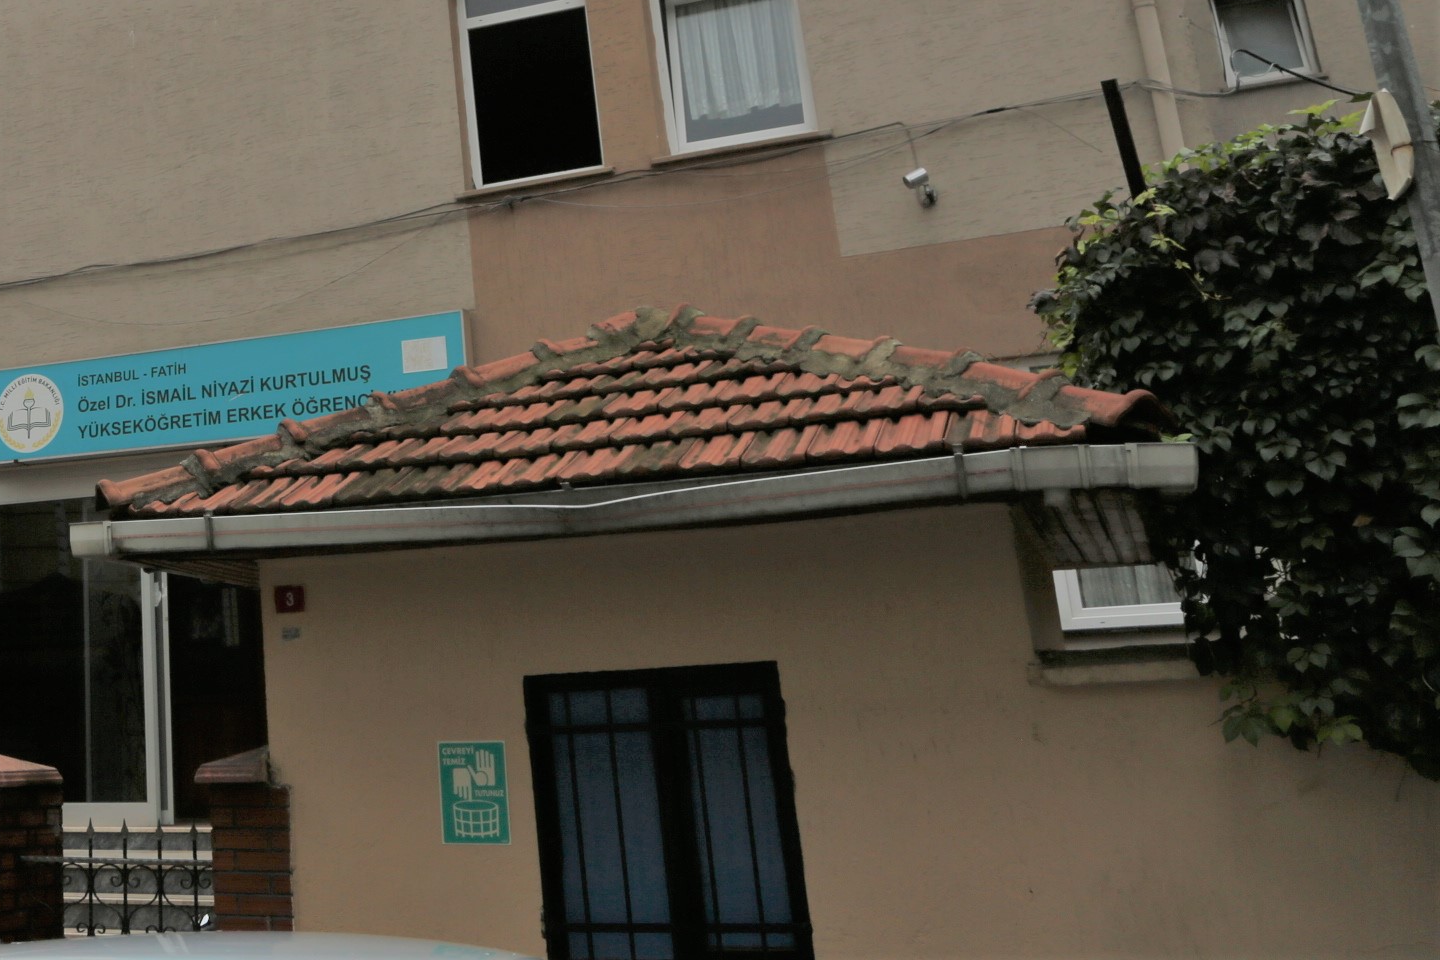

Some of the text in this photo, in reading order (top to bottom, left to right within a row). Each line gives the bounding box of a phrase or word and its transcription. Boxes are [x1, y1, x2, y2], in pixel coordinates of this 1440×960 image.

[78, 369, 139, 387] İSTANBUL
[151, 362, 187, 378] FATİH
[78, 364, 371, 413] Özel Dr. İSMAİL NİYAZİ KURTULMUŞ
[17, 376, 38, 386] EĞİTİM
[38, 378, 60, 406] BAKANLIĞI
[78, 390, 374, 439] YÜKSEKÖĞRETİM ERKEK ÖĞRENC
[286, 592, 294, 607] 3
